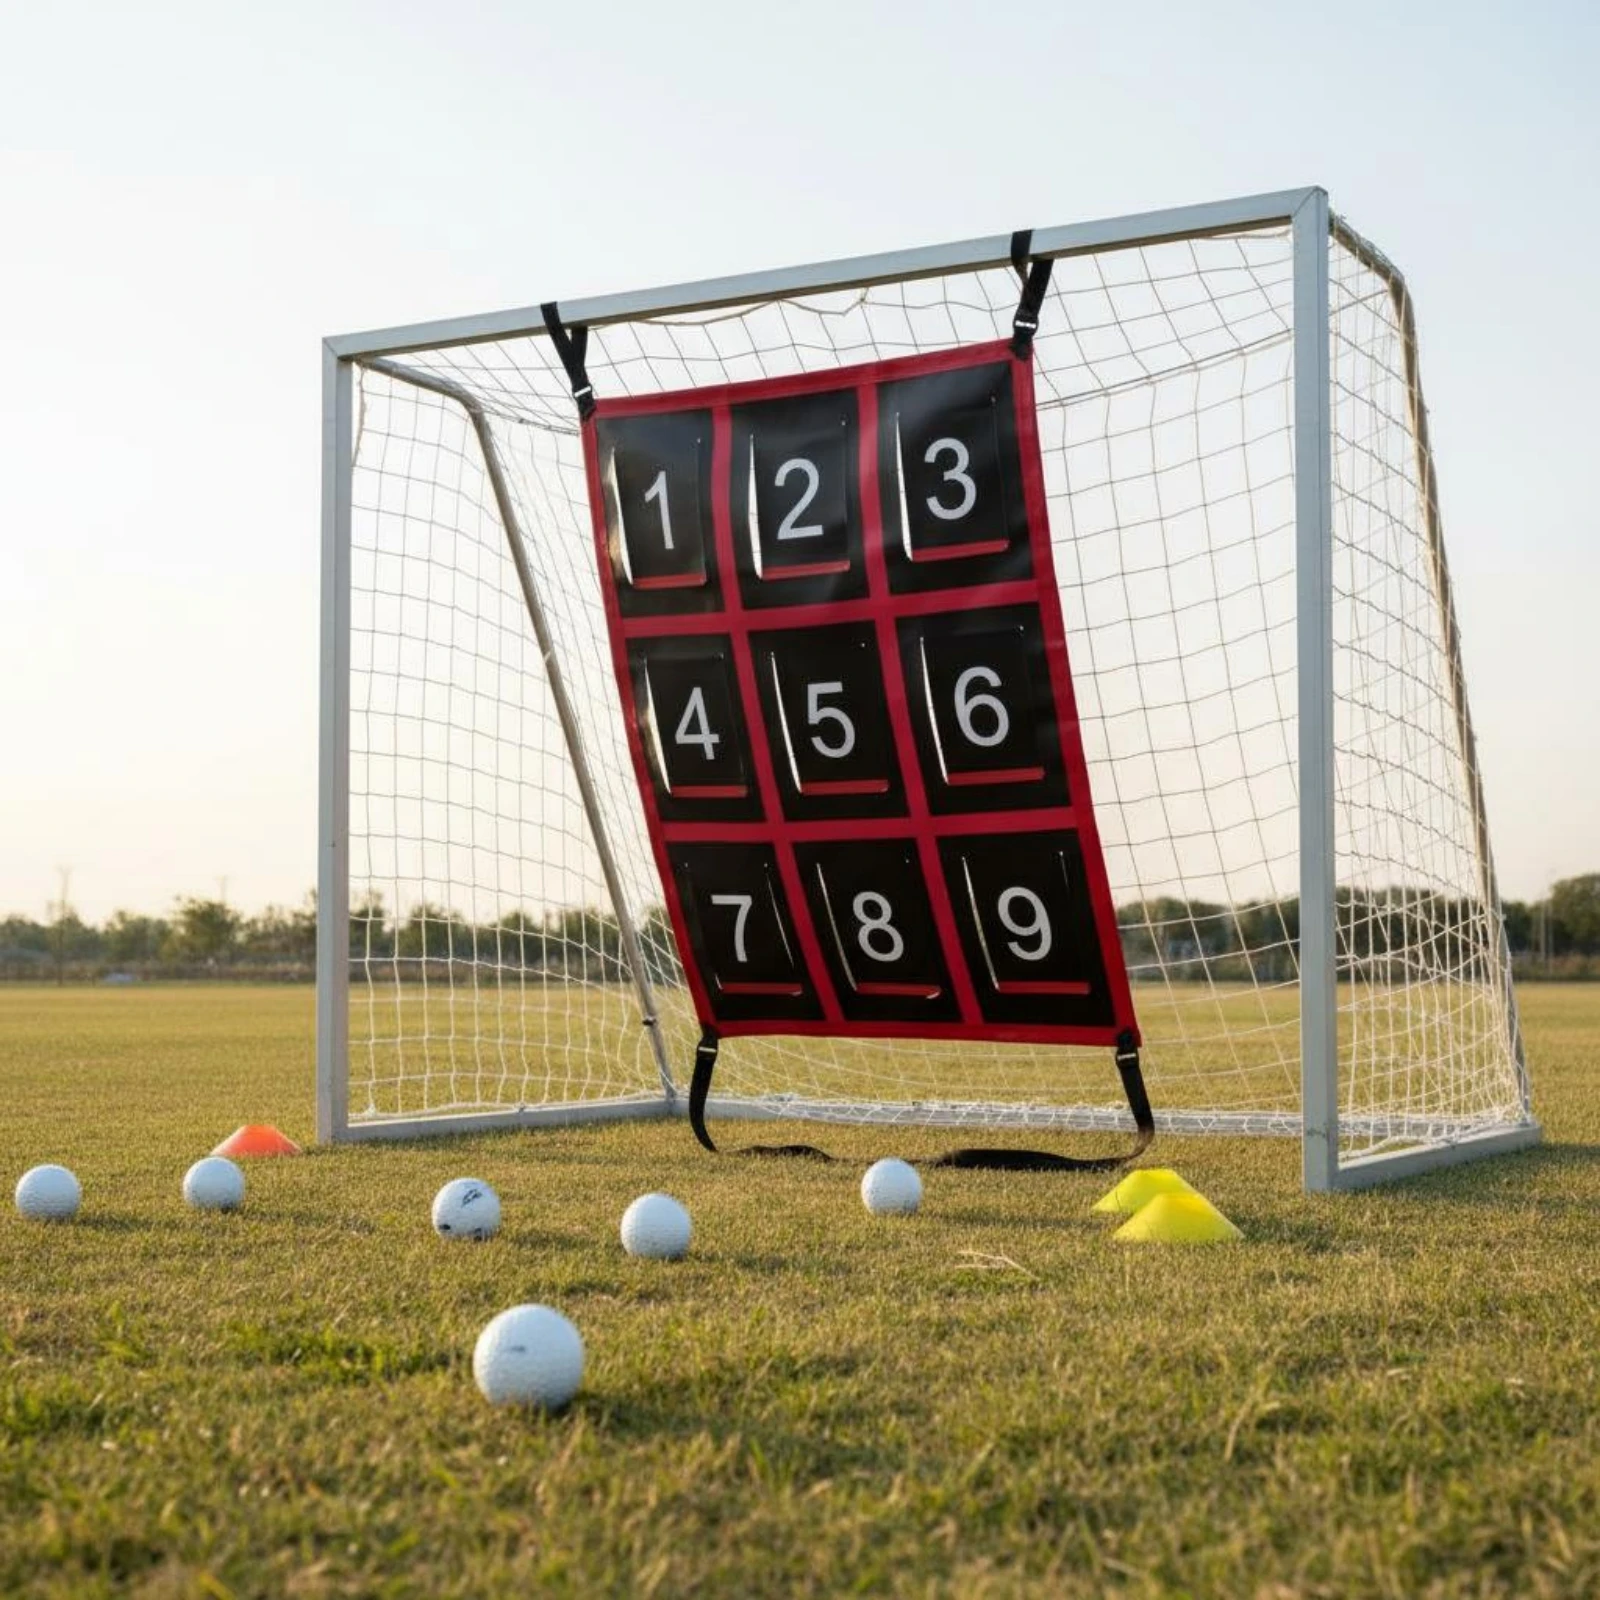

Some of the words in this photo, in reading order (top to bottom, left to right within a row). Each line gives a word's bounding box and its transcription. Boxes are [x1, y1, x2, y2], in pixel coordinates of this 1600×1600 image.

[643, 470, 675, 550] 1
[774, 458, 824, 540] 2
[924, 437, 977, 520] 3
[675, 686, 720, 760] 4
[807, 681, 855, 758] 5
[954, 666, 1009, 747] 6
[711, 894, 752, 964] 7
[853, 891, 904, 963] 8
[998, 886, 1052, 962] 9
